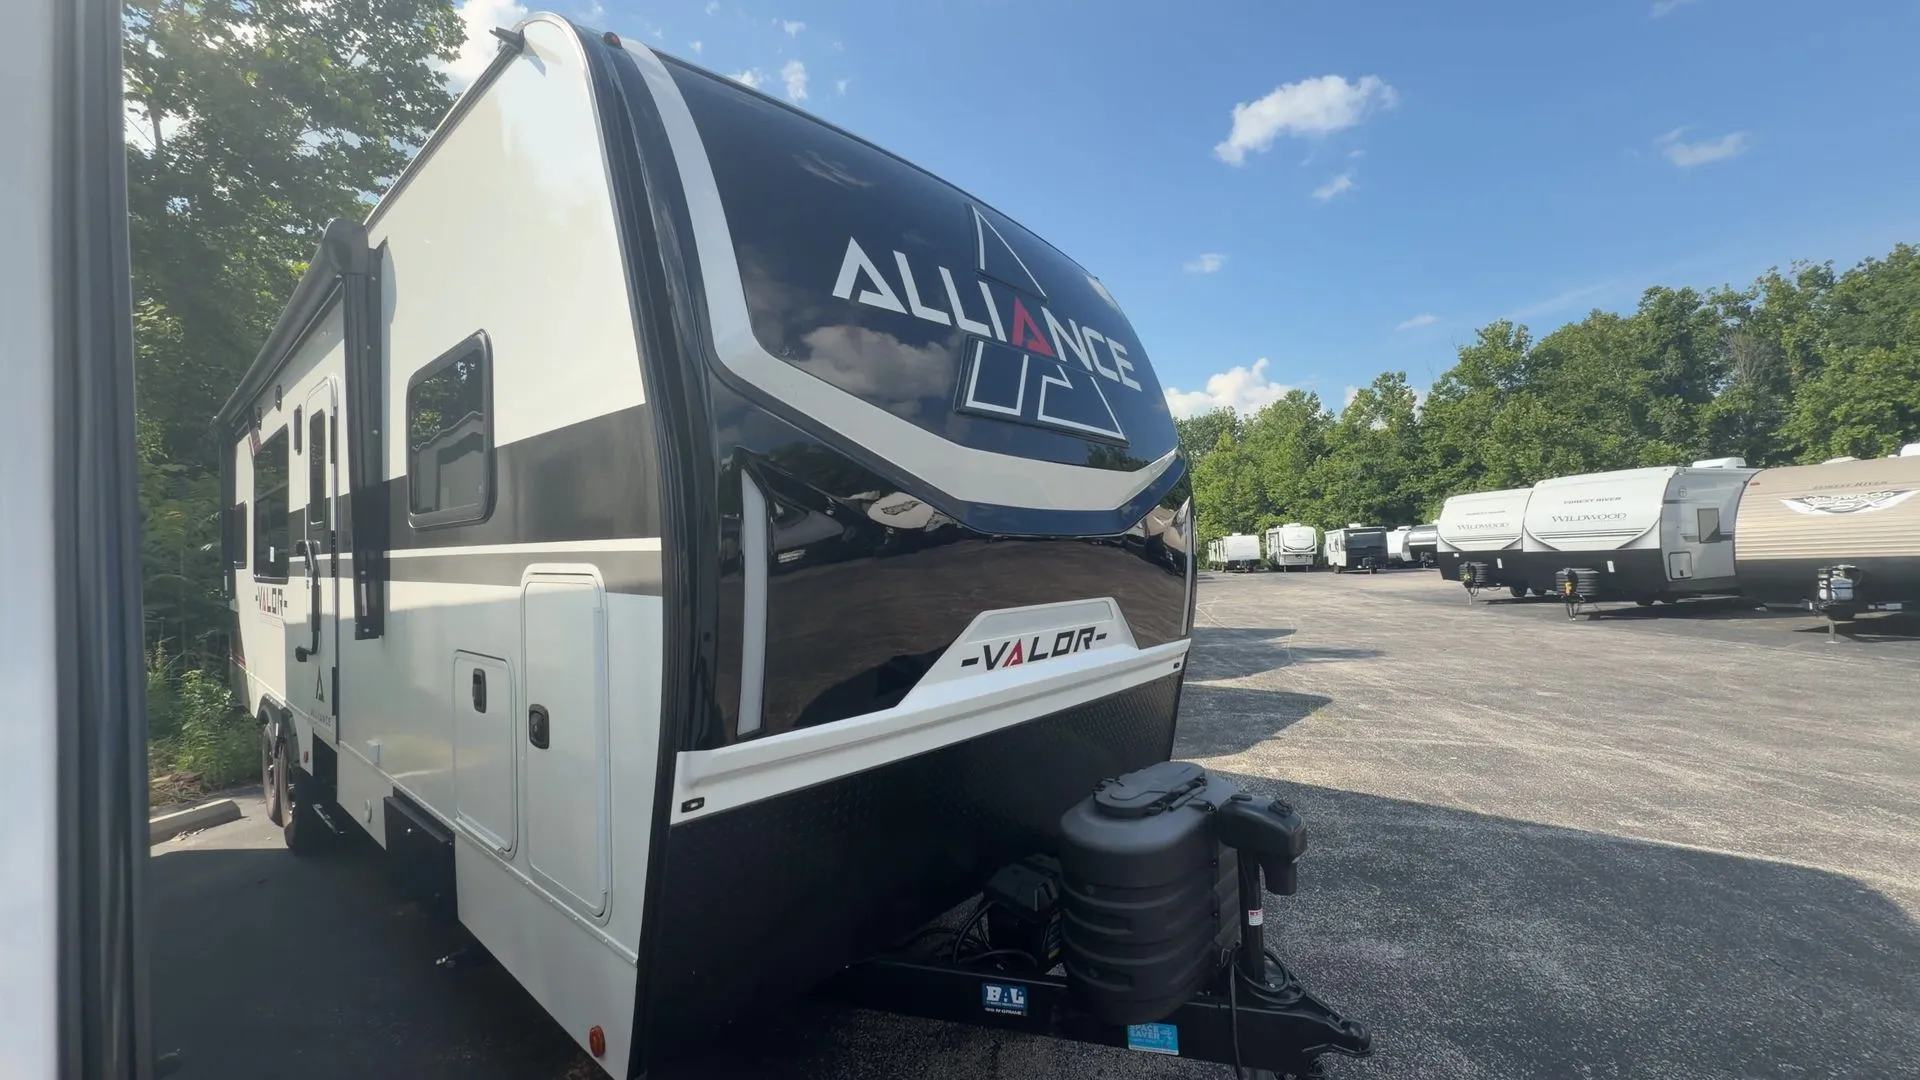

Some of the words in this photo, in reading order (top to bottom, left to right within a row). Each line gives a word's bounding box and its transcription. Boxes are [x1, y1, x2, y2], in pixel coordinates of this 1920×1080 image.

[832, 236, 1143, 392] ALLIANCE
[1552, 513, 1627, 522] WILDWOOD
[1457, 523, 1510, 531] WILDWOOD
